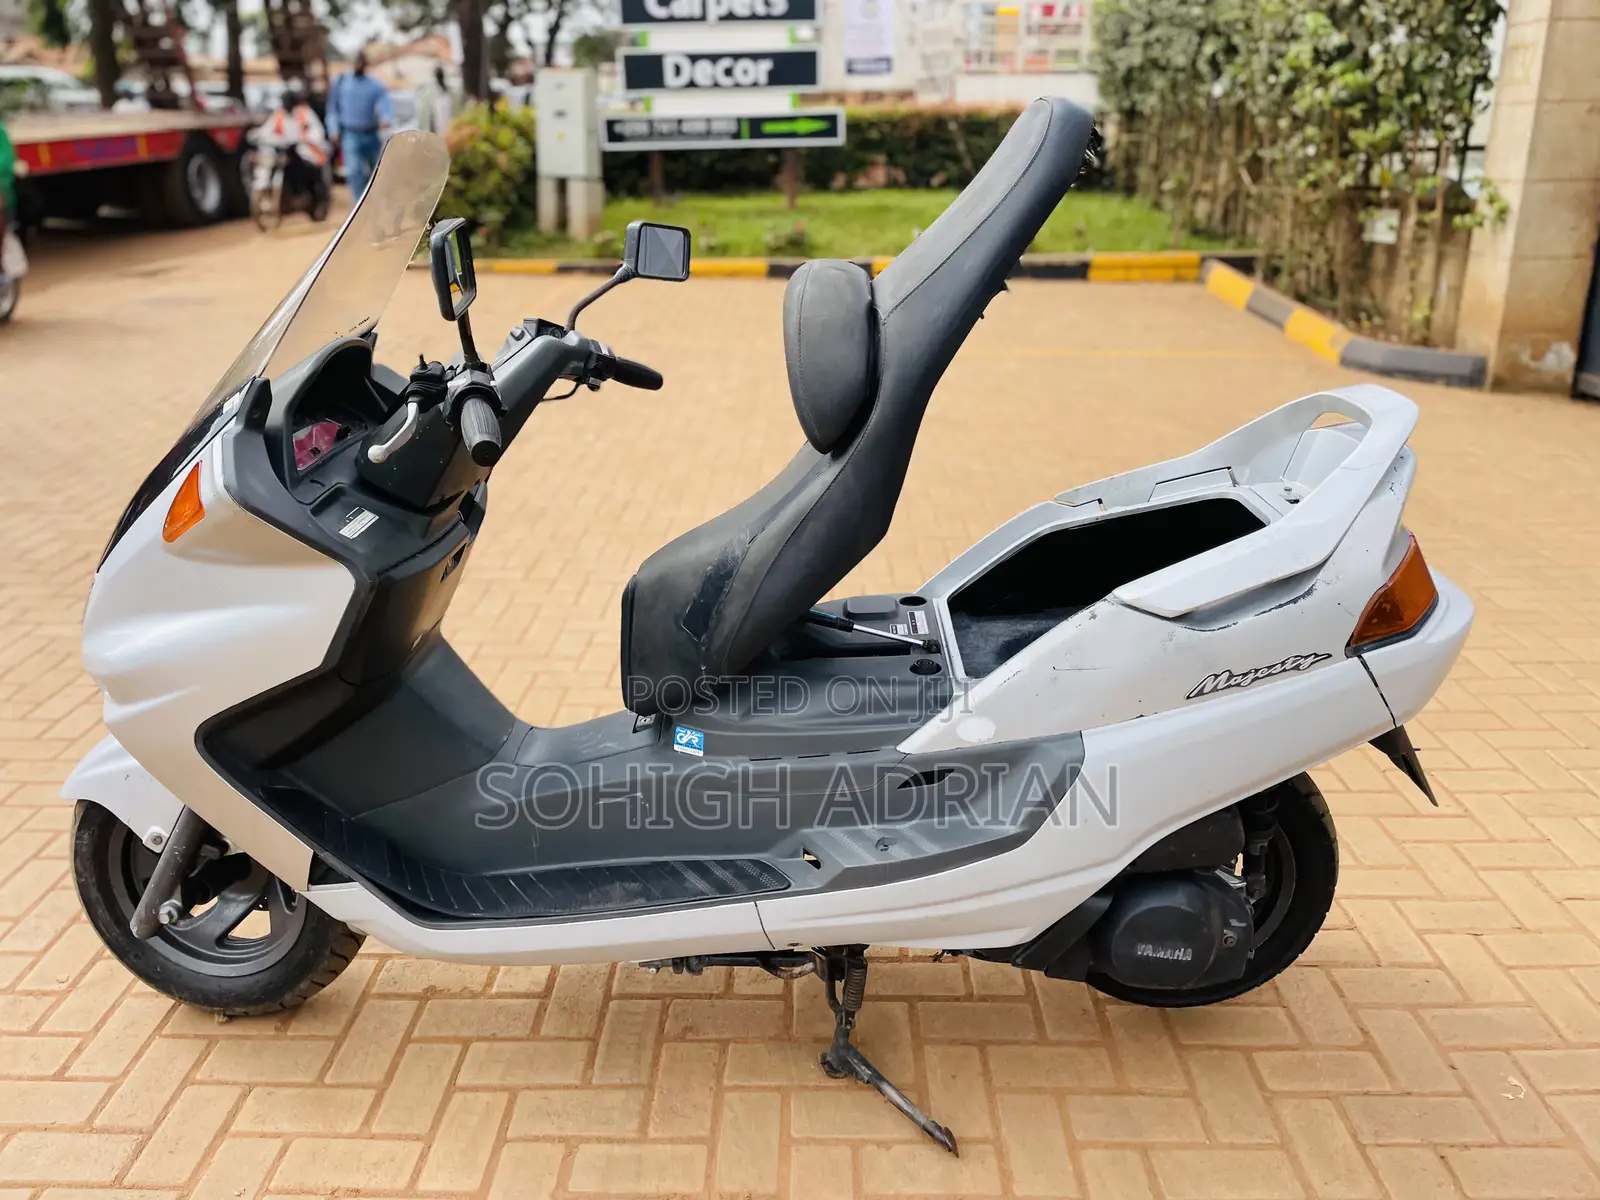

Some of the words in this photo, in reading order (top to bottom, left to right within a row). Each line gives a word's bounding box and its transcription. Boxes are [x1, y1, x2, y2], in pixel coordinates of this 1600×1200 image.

[644, 0, 790, 25] Carpets
[662, 53, 774, 89] Decor
[1185, 652, 1332, 699] Majesty
[1137, 943, 1193, 961] YAMAHA
